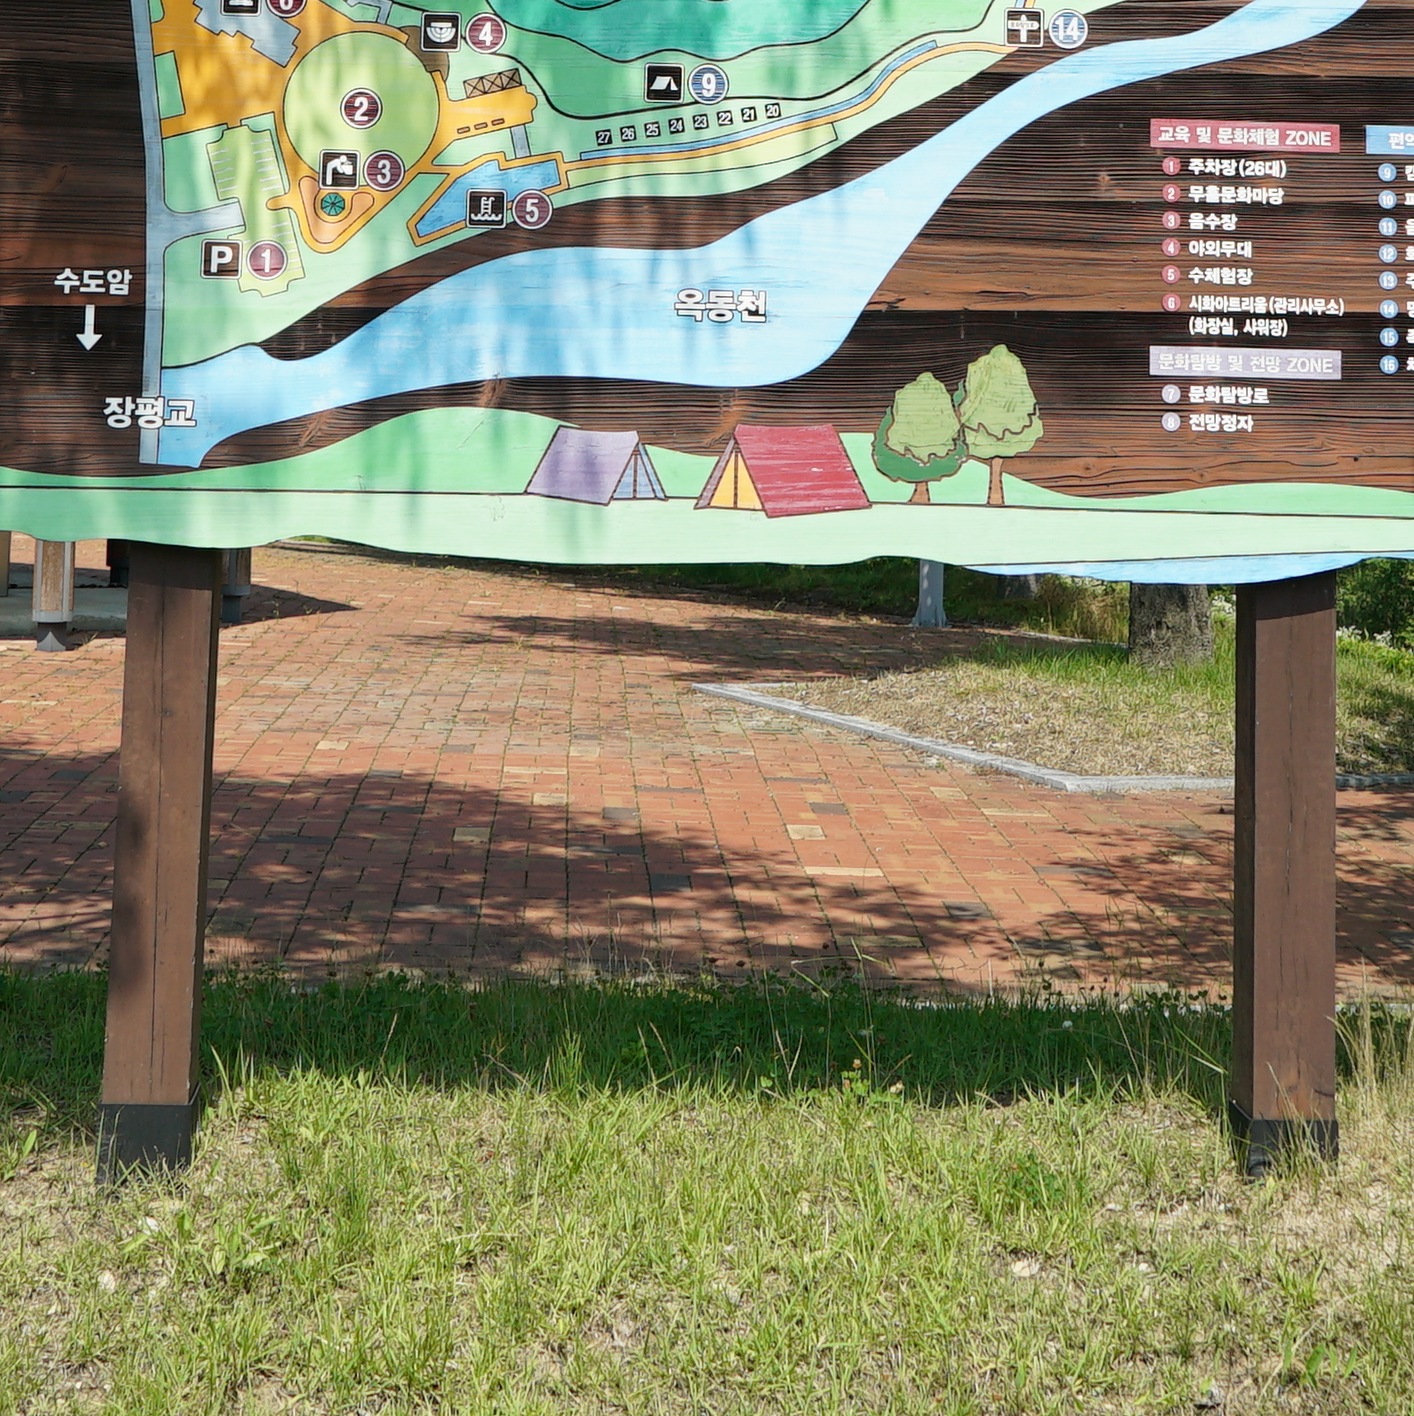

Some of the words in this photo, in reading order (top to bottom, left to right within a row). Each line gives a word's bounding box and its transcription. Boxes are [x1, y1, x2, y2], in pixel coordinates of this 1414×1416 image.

[479, 21, 492, 45] 4
[1055, 17, 1080, 40] 14
[702, 73, 715, 97] 9
[354, 97, 368, 121] 2
[743, 109, 755, 120] 21
[767, 105, 779, 116] 20
[695, 117, 706, 128] 23
[719, 113, 731, 124] 22
[646, 124, 658, 136] 25
[671, 120, 682, 131] 24
[598, 132, 610, 144] 27
[622, 128, 634, 139] 26
[1158, 126, 1190, 143] 교육
[1196, 127, 1211, 144] 및
[1217, 127, 1280, 145] 문화체험
[1285, 131, 1332, 146] ZONE
[378, 159, 391, 182] 3
[1169, 162, 1174, 172] 1
[1384, 168, 1390, 179] 9
[1168, 188, 1174, 199] 2
[1382, 195, 1394, 205] 10
[525, 198, 539, 221] 5
[1168, 215, 1174, 227] 3
[1189, 213, 1237, 230] 음수장
[1382, 222, 1393, 232] 11
[1167, 242, 1174, 253] 4
[1189, 240, 1252, 258] 야외무대
[1382, 249, 1393, 259] 12
[261, 249, 271, 271] 1
[54, 268, 132, 295] 수도암
[1168, 269, 1174, 280] 5
[1188, 267, 1254, 285] 수체험장
[674, 288, 767, 323] 옥동천
[1168, 297, 1174, 308] 6
[1382, 305, 1394, 314] 14
[1383, 332, 1394, 342] 15
[1158, 353, 1222, 371] 문화탐방
[1228, 355, 1242, 372] 및
[1250, 355, 1281, 373] 전망
[1287, 358, 1333, 373] ZONE
[1383, 360, 1395, 370] 16
[1167, 389, 1174, 400] 7
[1189, 386, 1269, 404] 문화탐방로
[103, 396, 197, 428] 장평교
[1167, 417, 1174, 428] 8
[1189, 414, 1254, 432] 전망정자
